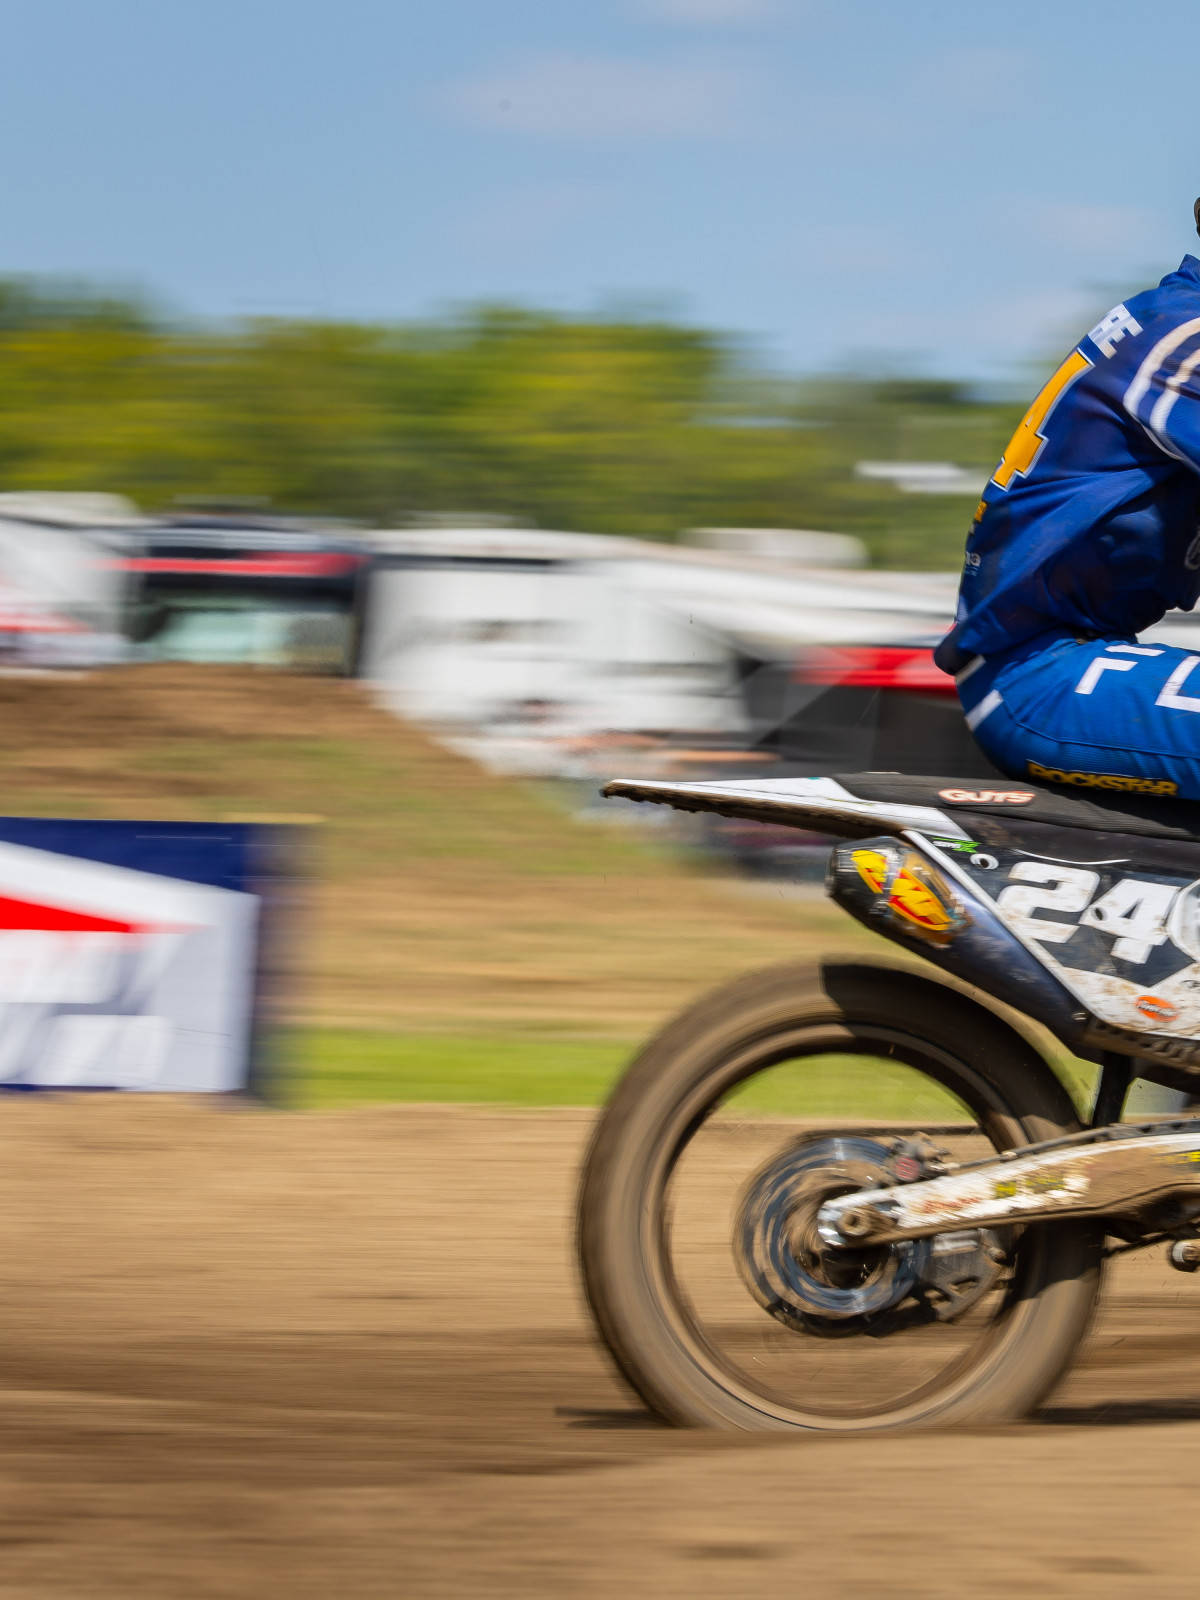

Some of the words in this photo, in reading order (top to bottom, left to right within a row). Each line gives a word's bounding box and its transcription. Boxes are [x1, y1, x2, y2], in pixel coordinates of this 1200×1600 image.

[937, 788, 1036, 803] GUTS
[1027, 763, 1179, 796] ROCKSTAR
[999, 861, 1181, 965] 24
